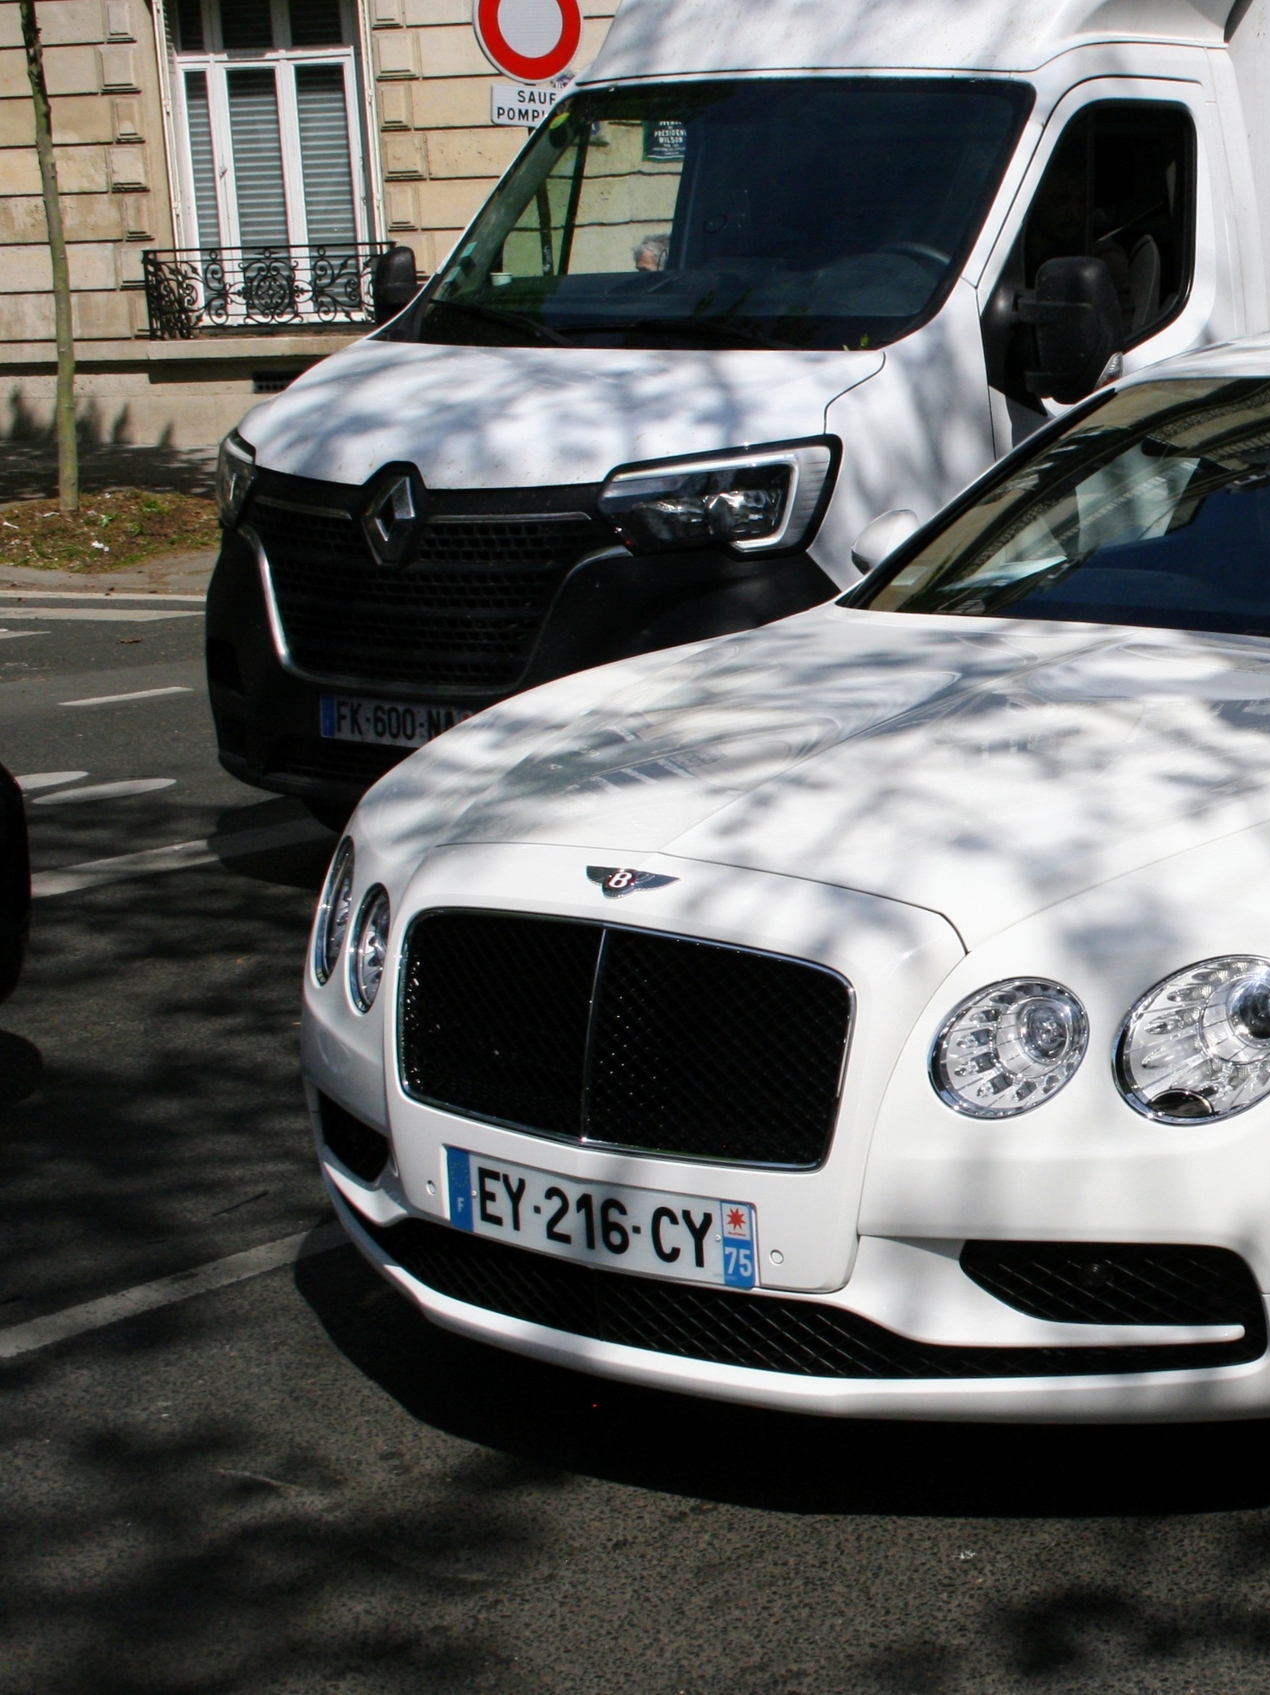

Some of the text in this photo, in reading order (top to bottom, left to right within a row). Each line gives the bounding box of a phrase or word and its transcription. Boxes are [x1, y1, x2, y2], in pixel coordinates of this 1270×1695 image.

[517, 90, 557, 105] SAUF
[456, 1196, 465, 1213] F
[724, 1246, 752, 1277] 75
